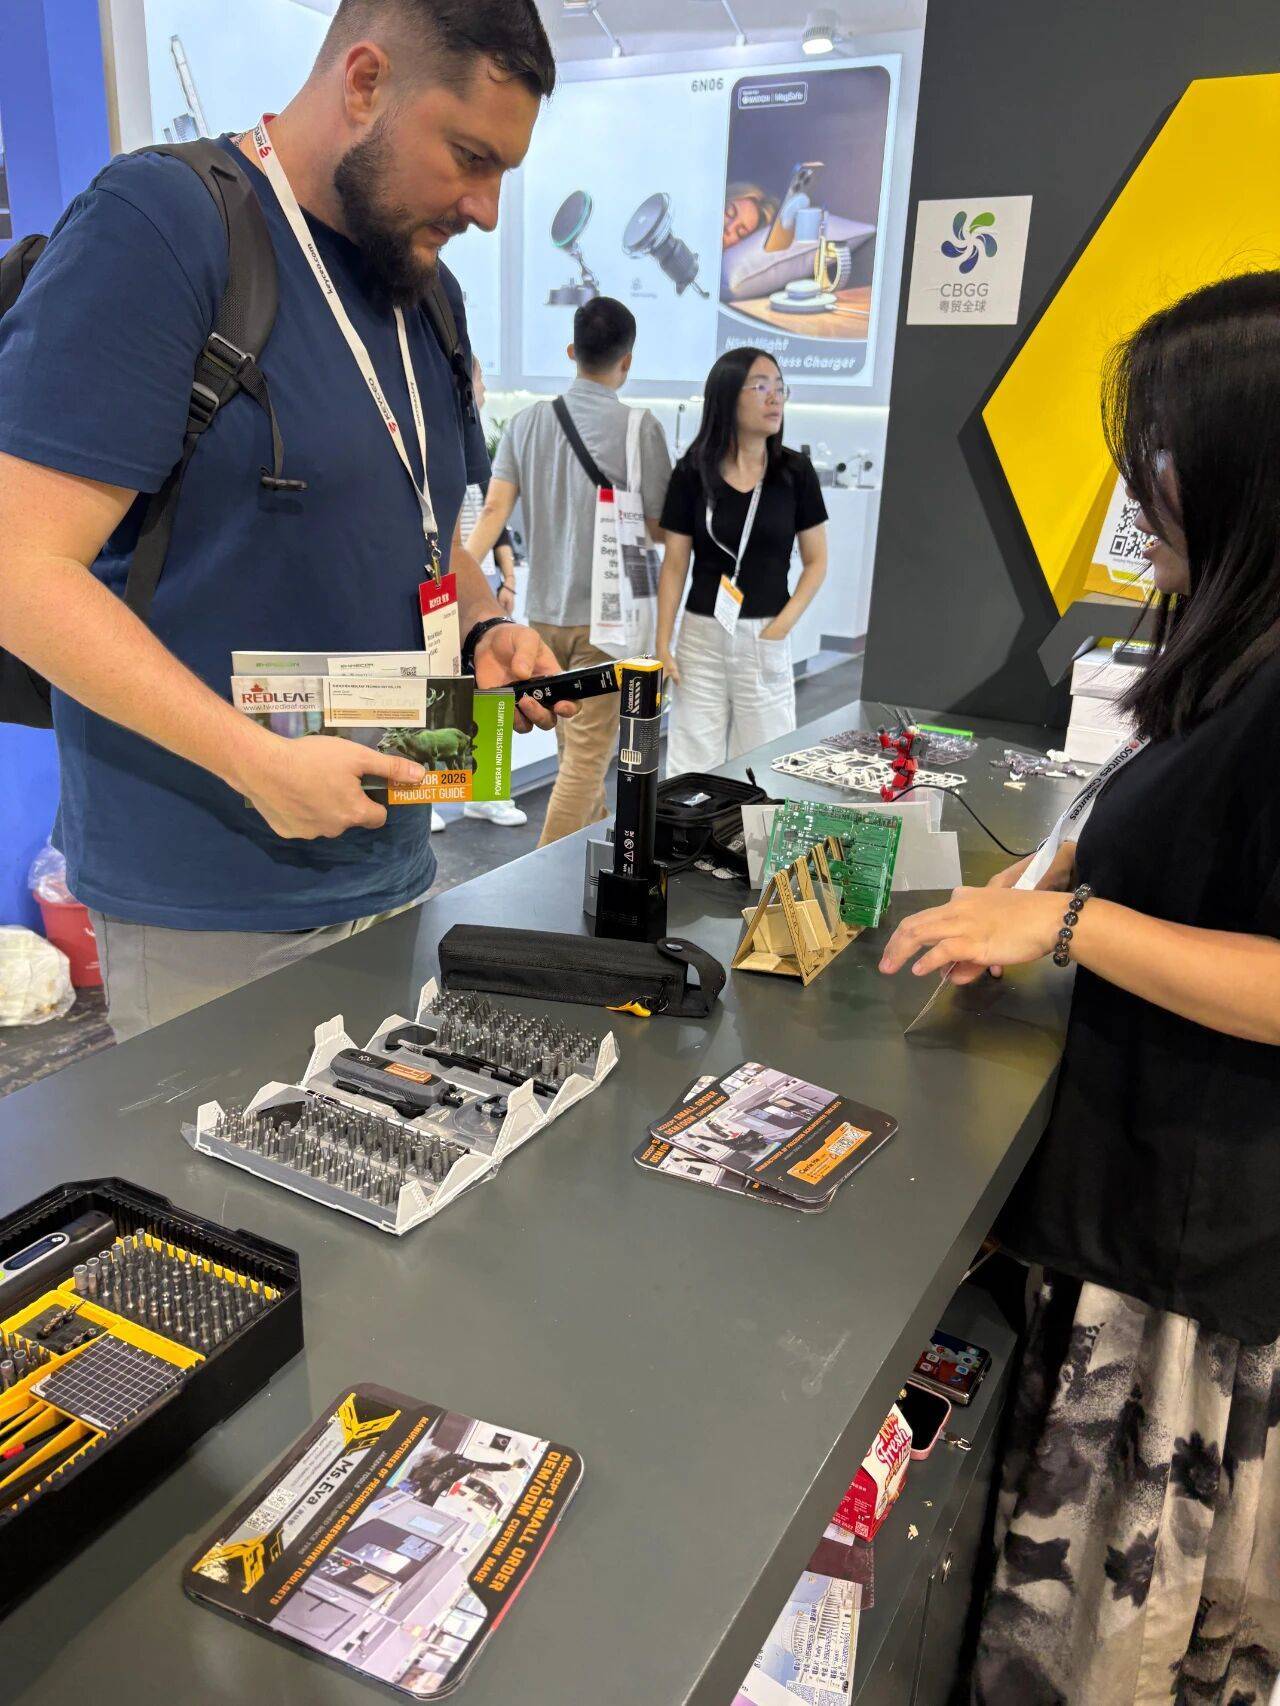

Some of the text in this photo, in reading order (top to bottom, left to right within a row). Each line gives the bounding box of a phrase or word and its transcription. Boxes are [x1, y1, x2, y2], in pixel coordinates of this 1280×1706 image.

[691, 78, 724, 93] 6N06
[307, 243, 333, 295] keyceo.com
[940, 283, 990, 297] CBGG
[803, 355, 856, 371] Charger
[241, 692, 316, 704] REDLEAF
[497, 701, 505, 727] LIMITED
[495, 728, 504, 767] INDUSTRIES
[1100, 746, 1133, 777] sources
[393, 786, 466, 801] PRODUCT GUIDE
[441, 773, 466, 785] 2026
[385, 1416, 429, 1468] MANUFACTURER
[877, 1424, 910, 1468] Fresh
[306, 1458, 354, 1505] Ms.Eva
[377, 1467, 389, 1478] OF
[346, 1478, 380, 1515] PRECISION
[474, 1451, 561, 1583] OEM/ODM CUSTOM MADE
[488, 1454, 573, 1592] ACCECPT SMALL ORDER
[302, 1514, 350, 1567] SCREWDRIVER
[269, 1567, 307, 1605] TOOLSETS
